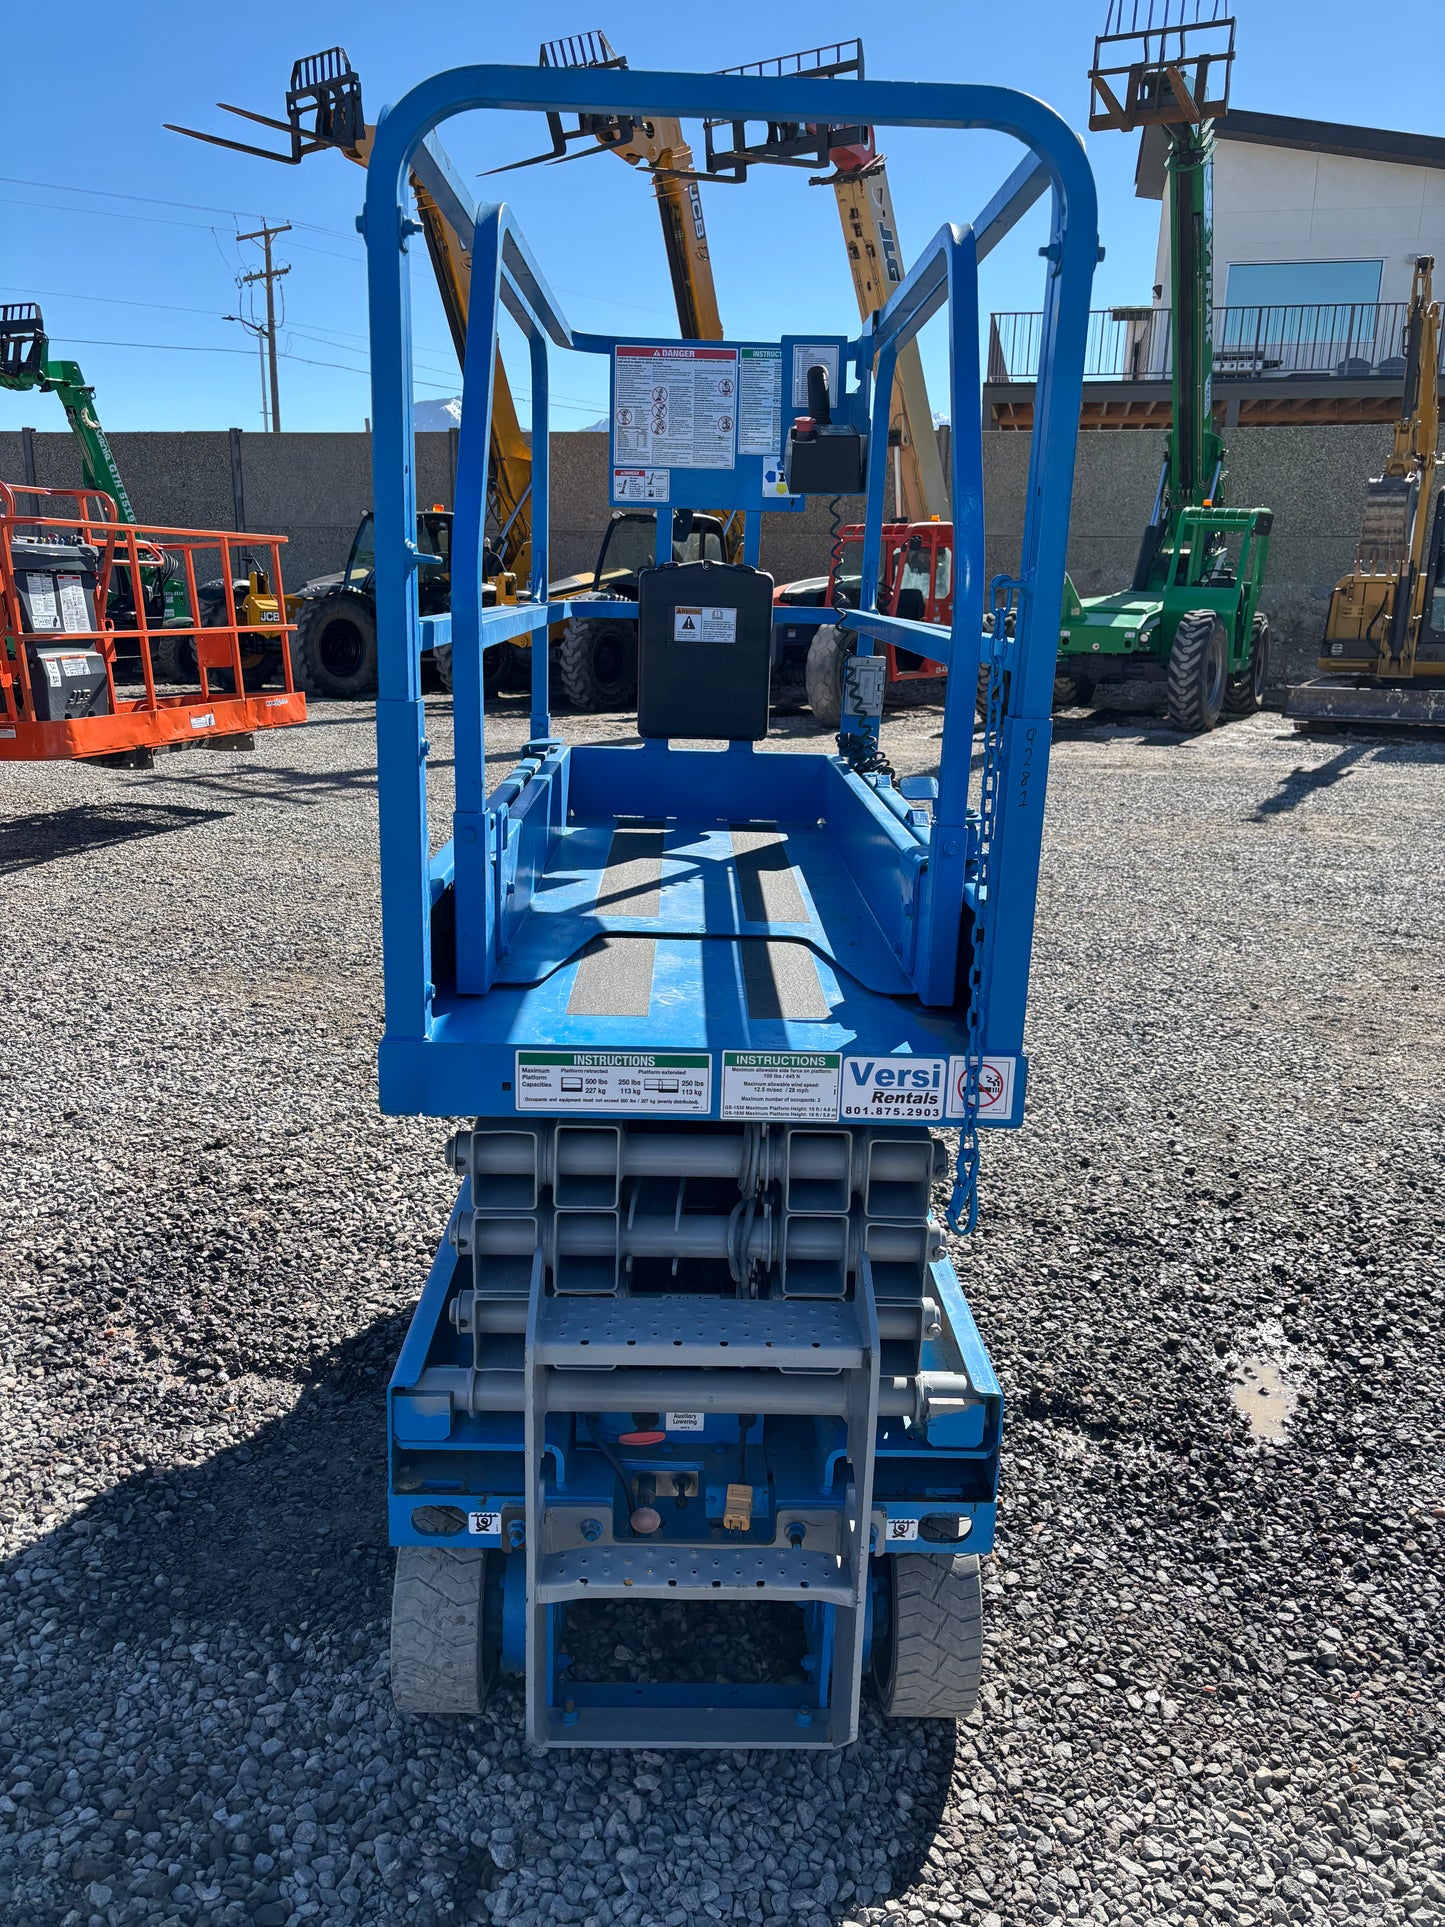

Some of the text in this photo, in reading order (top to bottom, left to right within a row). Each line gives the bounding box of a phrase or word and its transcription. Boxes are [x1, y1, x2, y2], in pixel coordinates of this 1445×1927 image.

[689, 183, 706, 240] JCB
[879, 222, 900, 282] JLG
[662, 350, 695, 358] DANGER
[96, 429, 111, 460] Genie
[109, 464, 123, 488] GTH
[260, 611, 280, 622] JCB
[68, 688, 91, 704] JLG
[574, 1055, 656, 1066] INSTRUCTIONS
[736, 1055, 826, 1066] INSTRUCTIONS
[850, 1062, 941, 1088] Versi
[871, 1090, 938, 1105] Rentals
[844, 1106, 940, 1117] 801.875.2903
